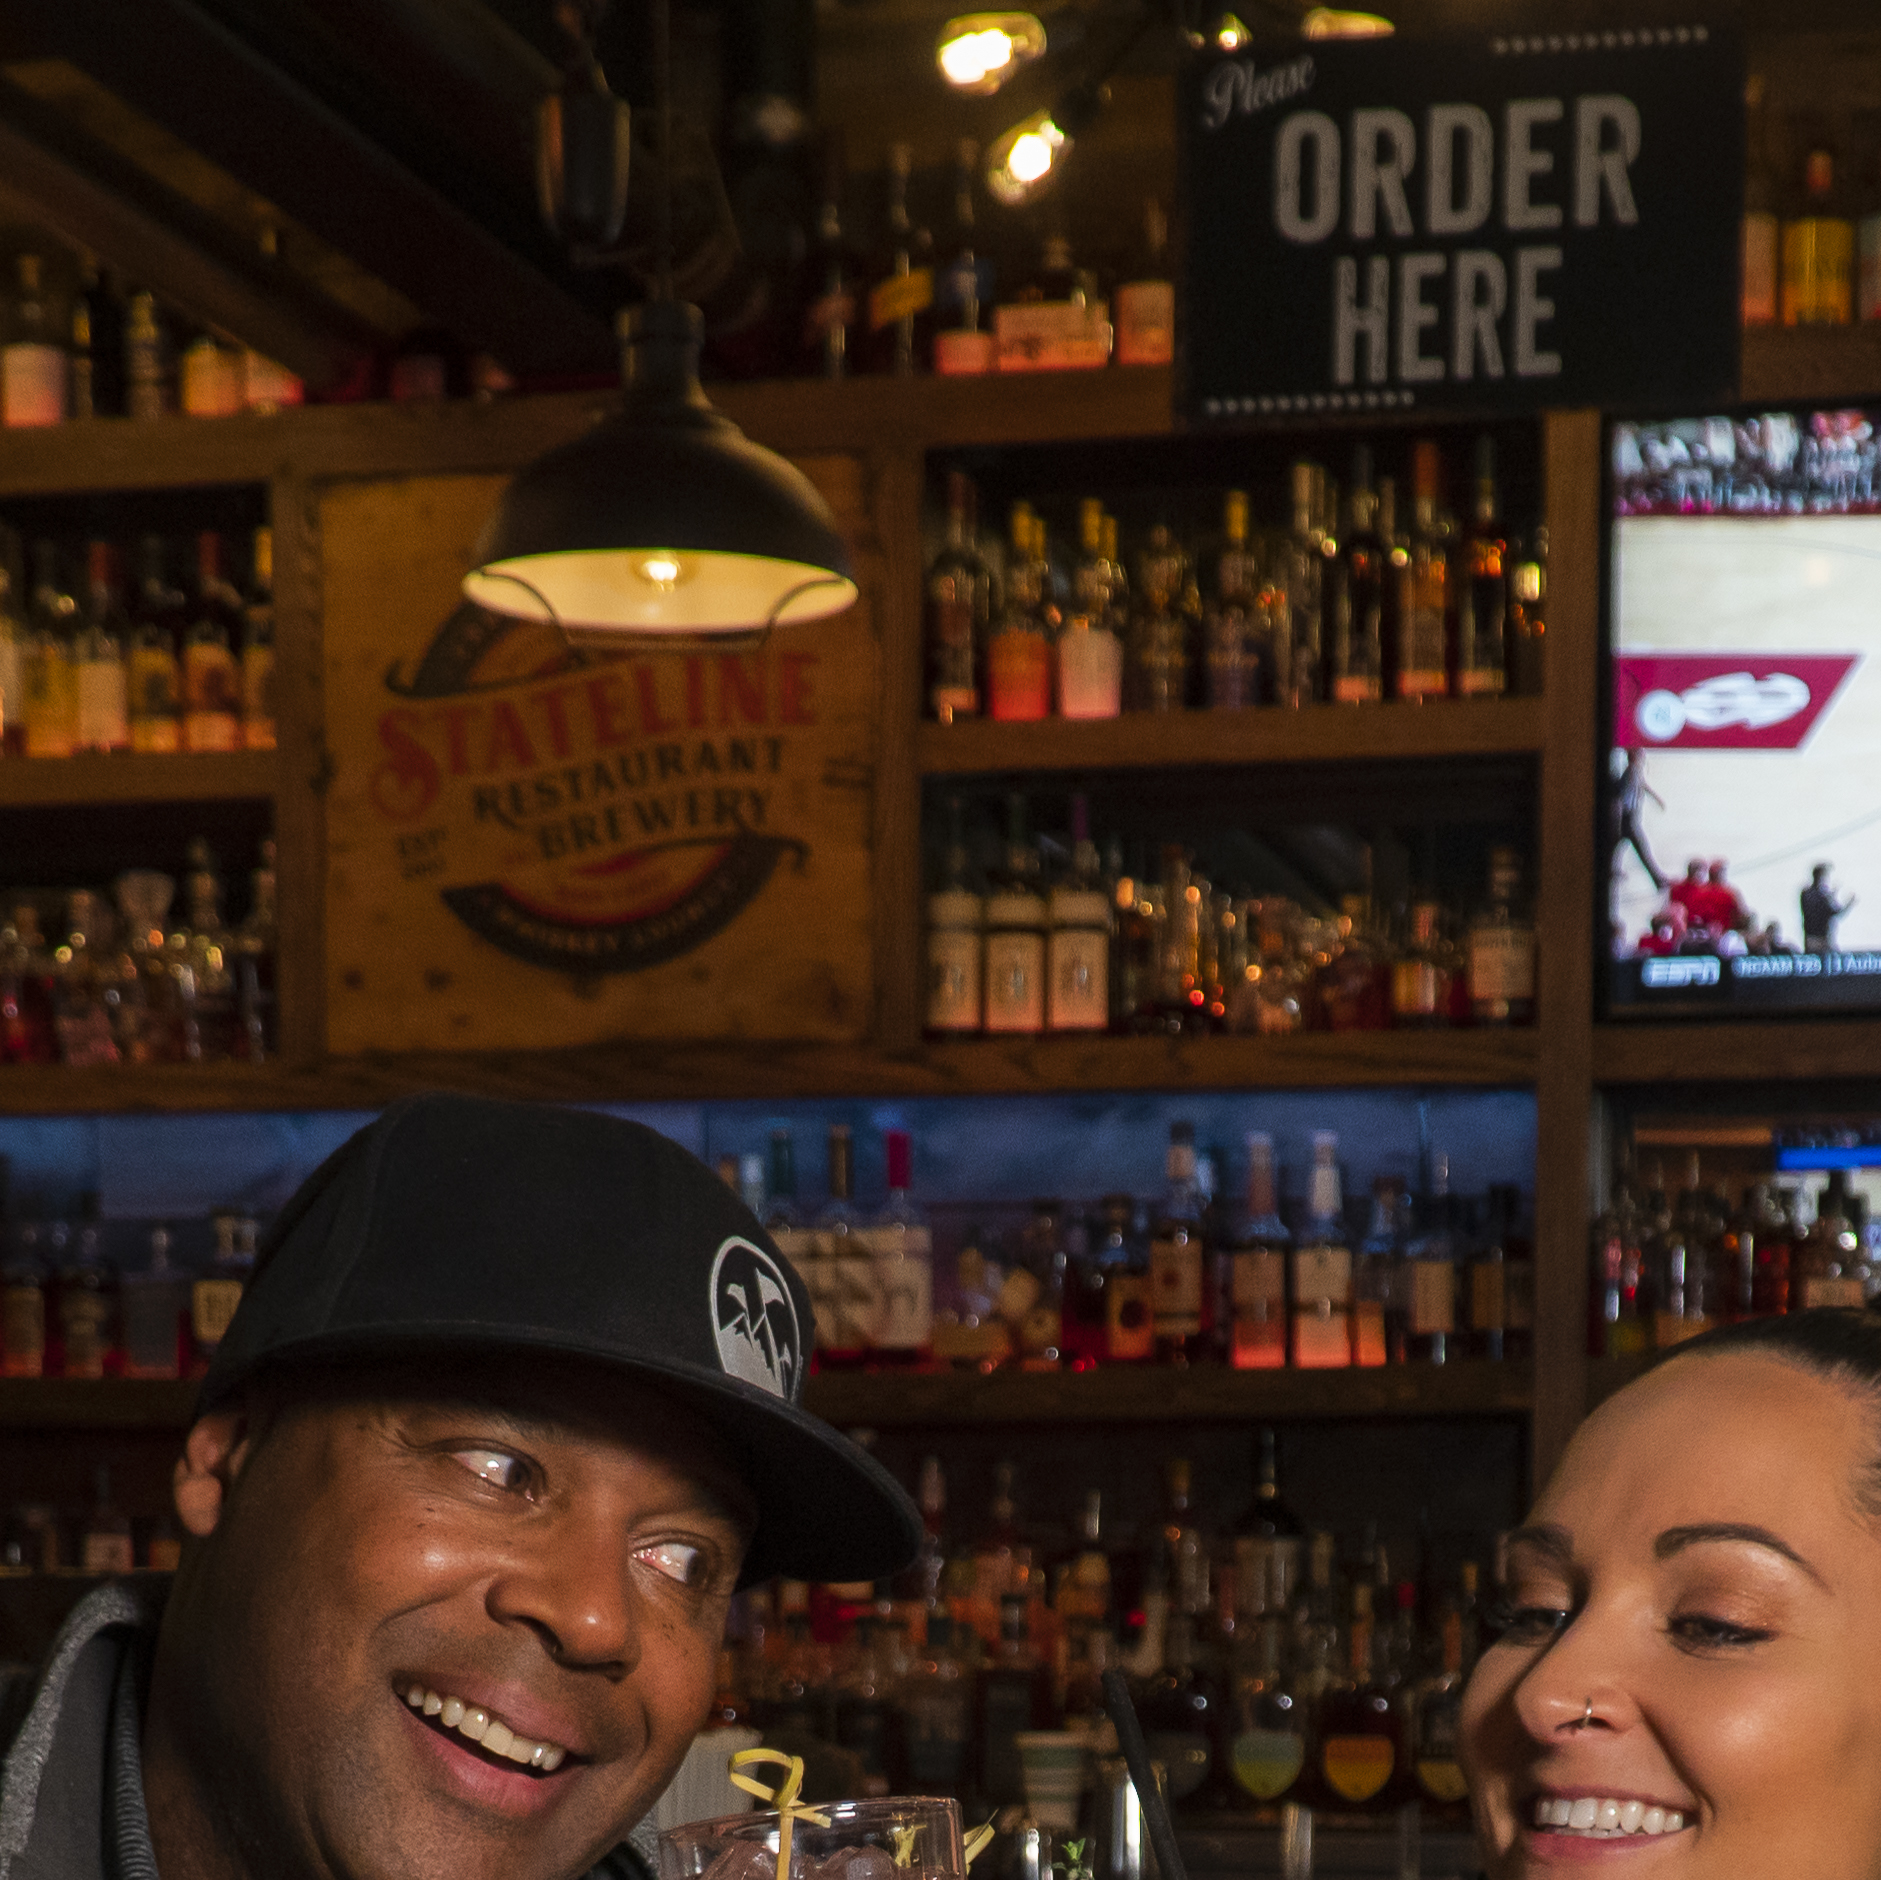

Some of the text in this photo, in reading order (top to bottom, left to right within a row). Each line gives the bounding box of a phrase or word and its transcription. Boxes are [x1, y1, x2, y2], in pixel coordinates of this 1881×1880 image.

[1202, 54, 1315, 129] Please
[1272, 93, 1642, 244] ORDER
[1331, 245, 1563, 386] HERE
[369, 650, 820, 826] STATELINE
[471, 735, 786, 832] RESTAURANT
[536, 784, 775, 863] BREWERY
[1642, 955, 1721, 987] ESPN
